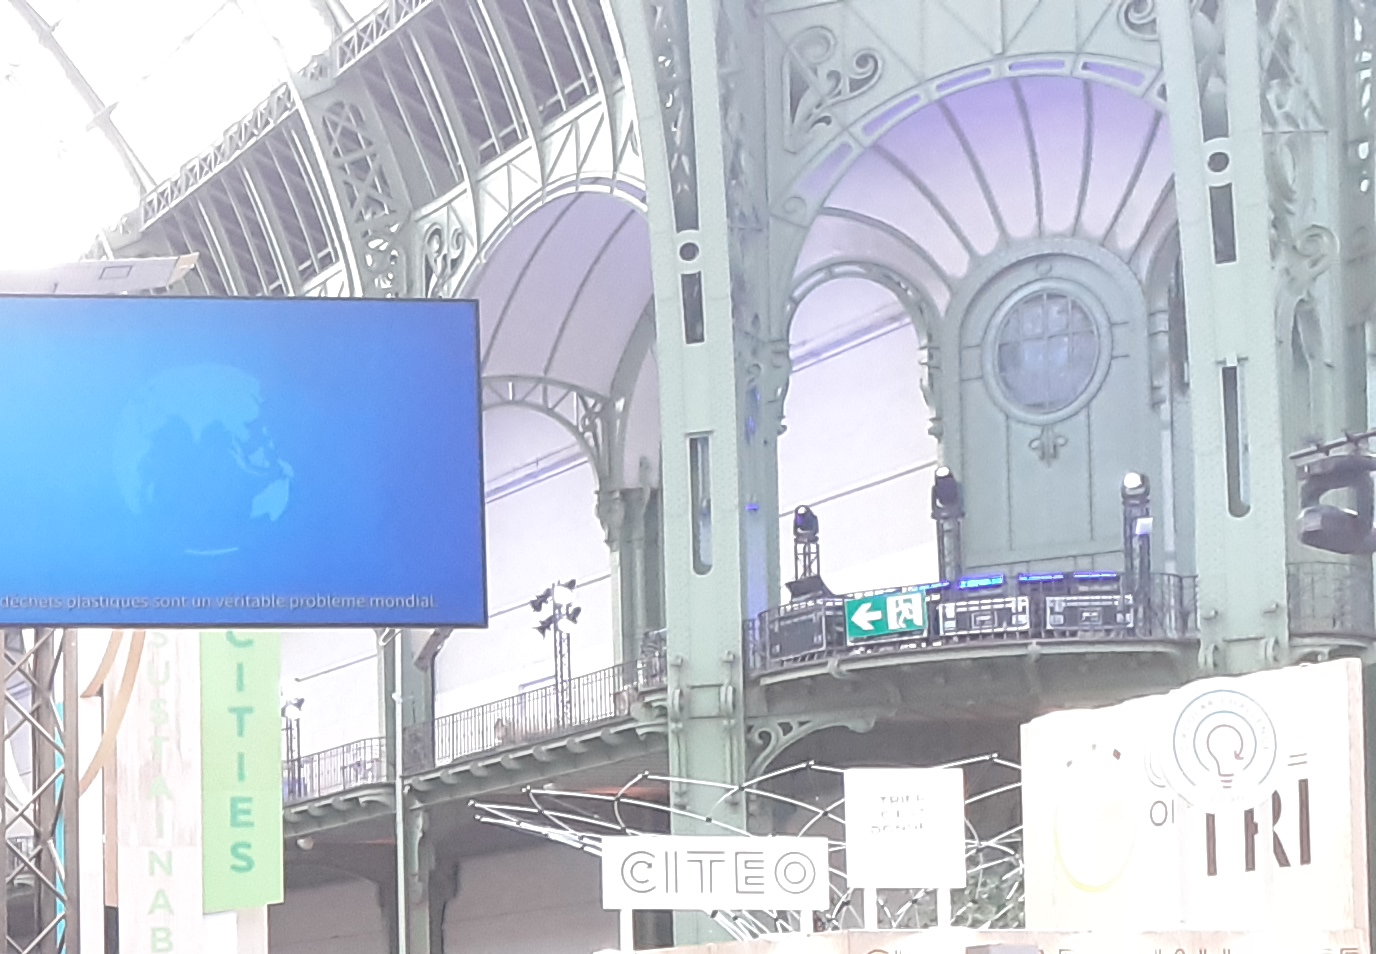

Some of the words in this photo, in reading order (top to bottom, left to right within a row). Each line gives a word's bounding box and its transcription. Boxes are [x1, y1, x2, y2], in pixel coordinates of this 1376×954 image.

[0, 593, 62, 609] déchets
[67, 594, 148, 612] plastiques
[152, 595, 187, 609] sont
[192, 597, 210, 609] un
[621, 851, 816, 895] CITEO
